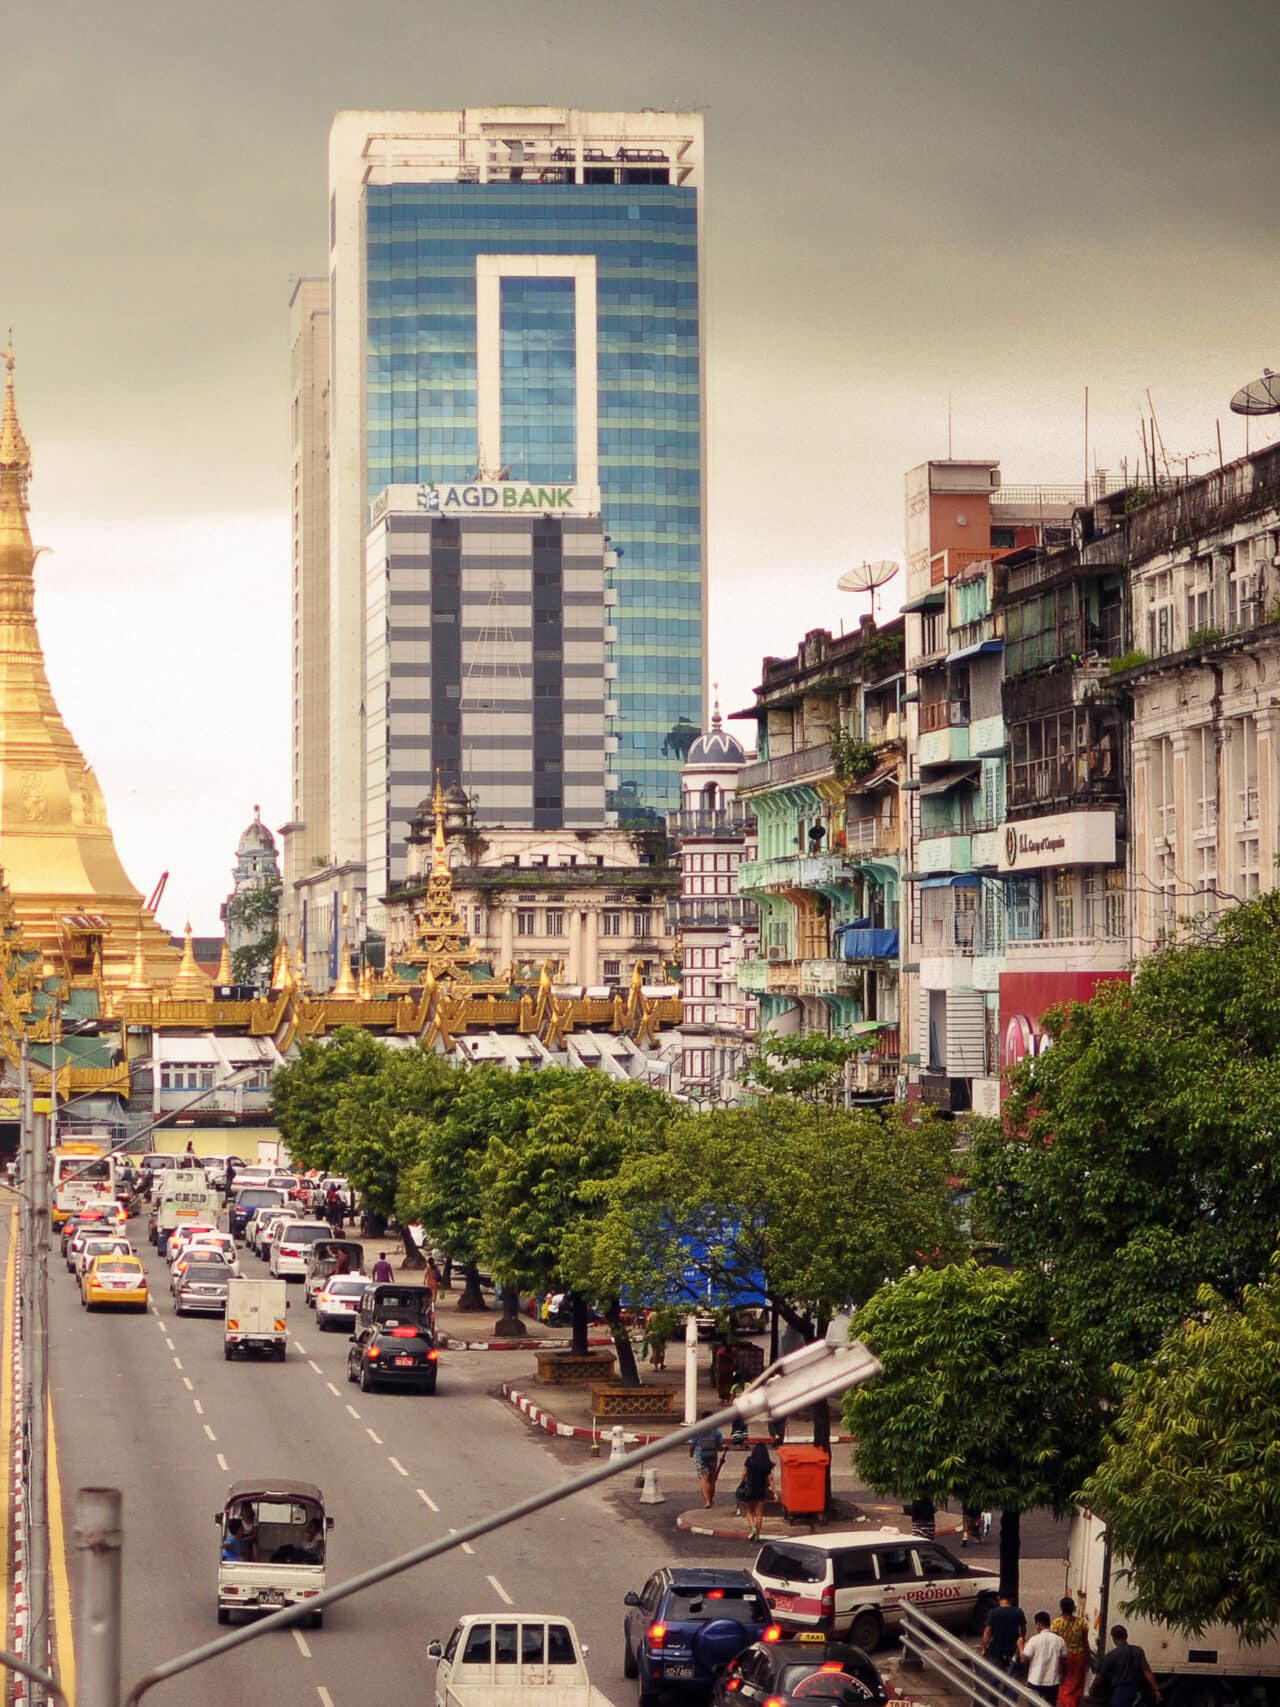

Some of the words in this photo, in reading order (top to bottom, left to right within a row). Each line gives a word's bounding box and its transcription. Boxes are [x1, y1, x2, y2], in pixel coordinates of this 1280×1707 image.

[444, 486, 499, 508] AGD
[502, 487, 575, 509] BANK
[907, 1586, 961, 1602] PROBOX
